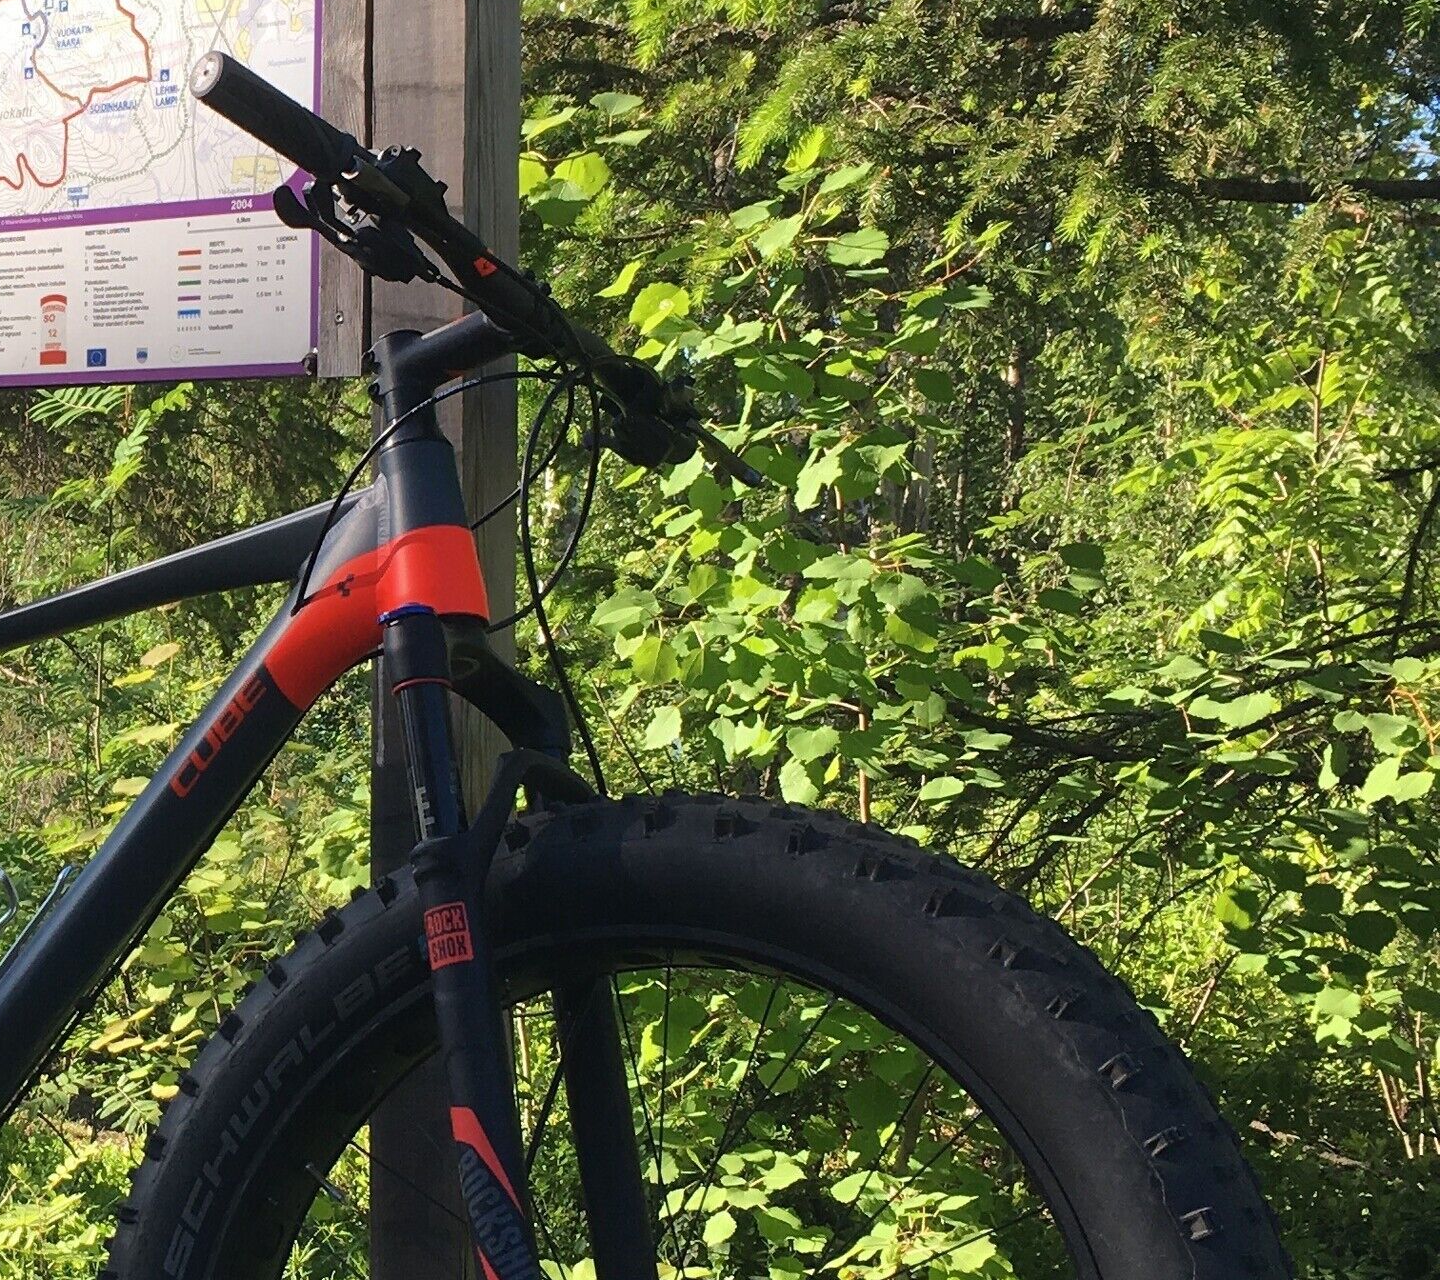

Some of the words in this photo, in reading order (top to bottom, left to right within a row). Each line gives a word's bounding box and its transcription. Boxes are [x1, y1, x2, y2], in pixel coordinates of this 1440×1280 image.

[231, 199, 253, 210] 2004
[48, 329, 57, 338] 12
[169, 672, 267, 798] CUBE
[426, 907, 466, 938] ROCK
[431, 934, 468, 963] SHOX
